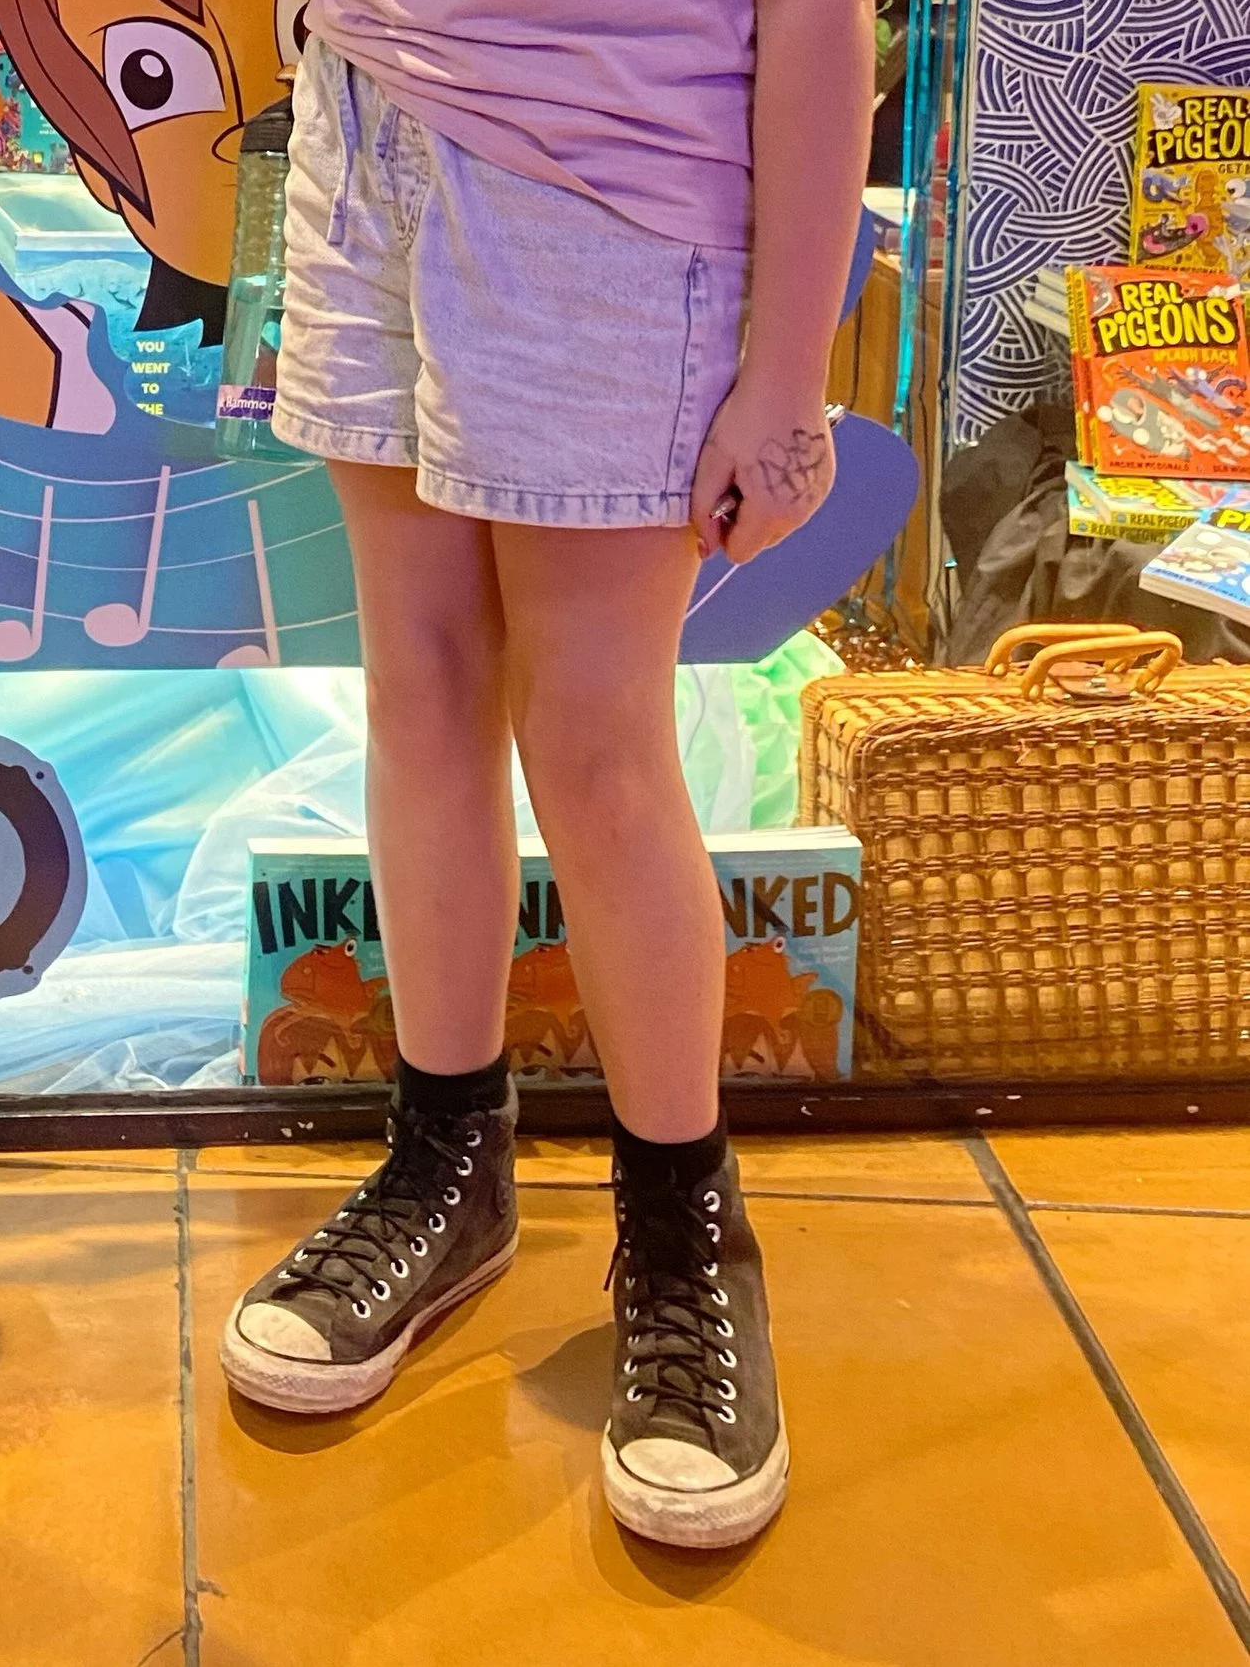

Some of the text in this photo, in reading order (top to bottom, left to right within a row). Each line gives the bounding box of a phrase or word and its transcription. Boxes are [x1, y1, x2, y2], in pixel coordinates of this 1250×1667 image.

[1185, 98, 1246, 125] REAL
[1218, 164, 1241, 175] GET
[1121, 282, 1183, 310] REAL
[136, 341, 164, 353] YOU
[1154, 351, 1238, 364] SPLASH BACK
[132, 362, 171, 374] WENT
[141, 383, 160, 394] TO
[1130, 514, 1156, 526] REAL
[717, 872, 860, 938] NKED
